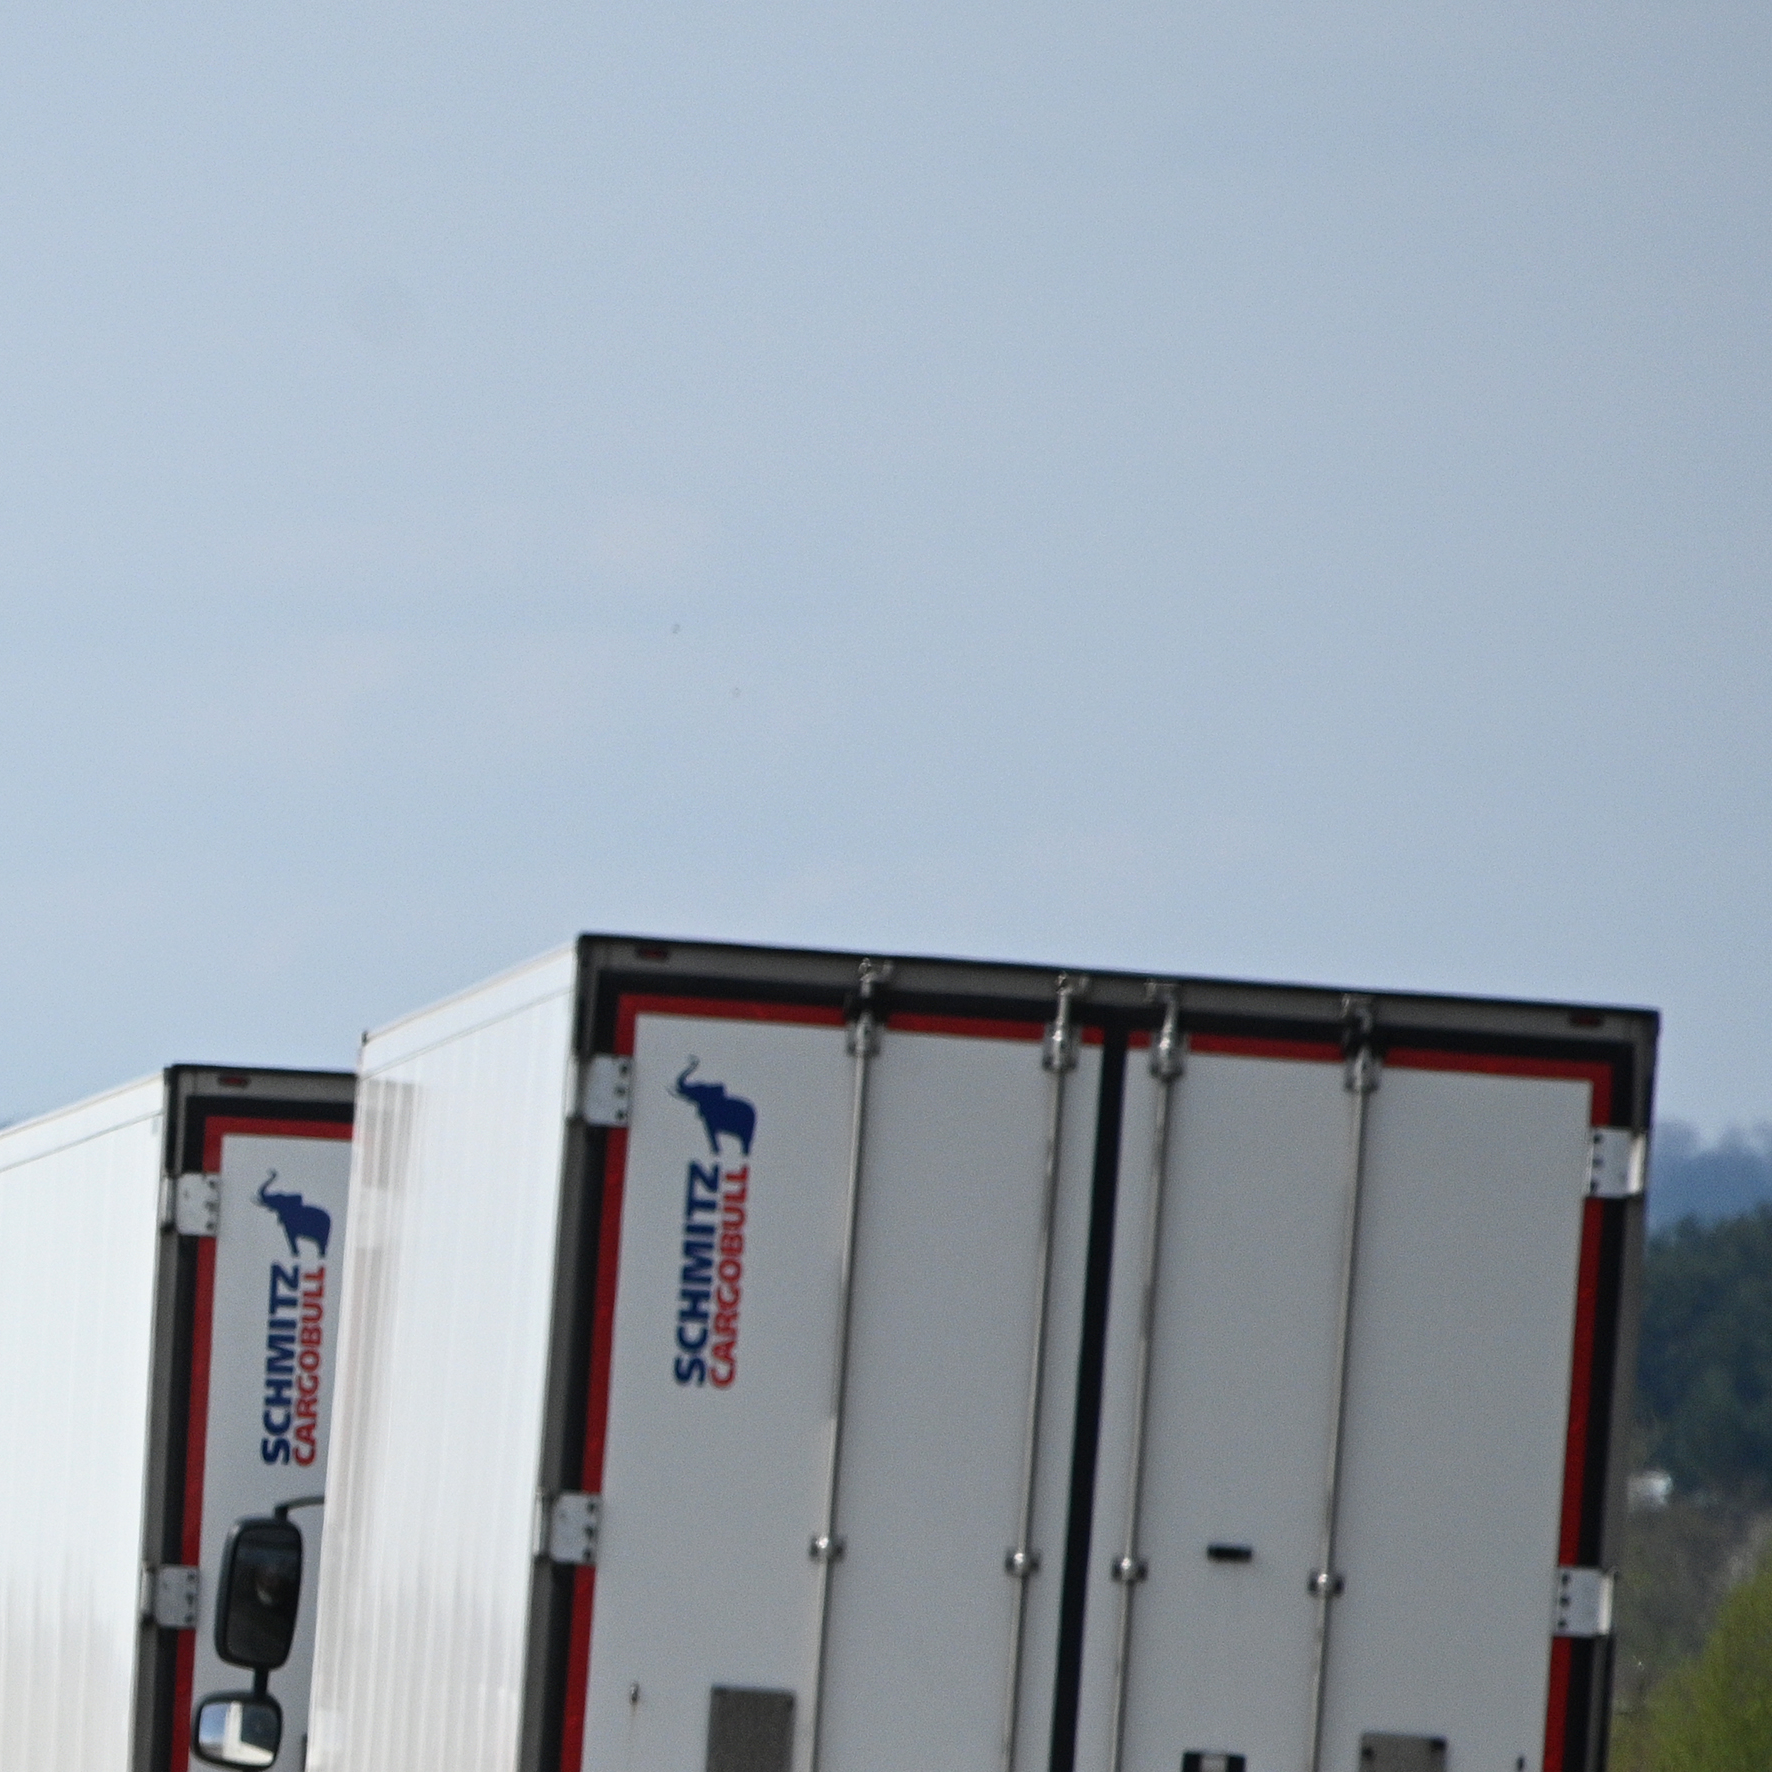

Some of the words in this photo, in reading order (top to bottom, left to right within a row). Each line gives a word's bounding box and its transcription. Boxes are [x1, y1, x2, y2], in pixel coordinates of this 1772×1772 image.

[260, 1263, 300, 1466] SCHMITZ
[291, 1266, 326, 1468] CARGOBULL
[673, 1160, 721, 1387] SCHMITZ
[710, 1163, 750, 1390] CARGOBULL
